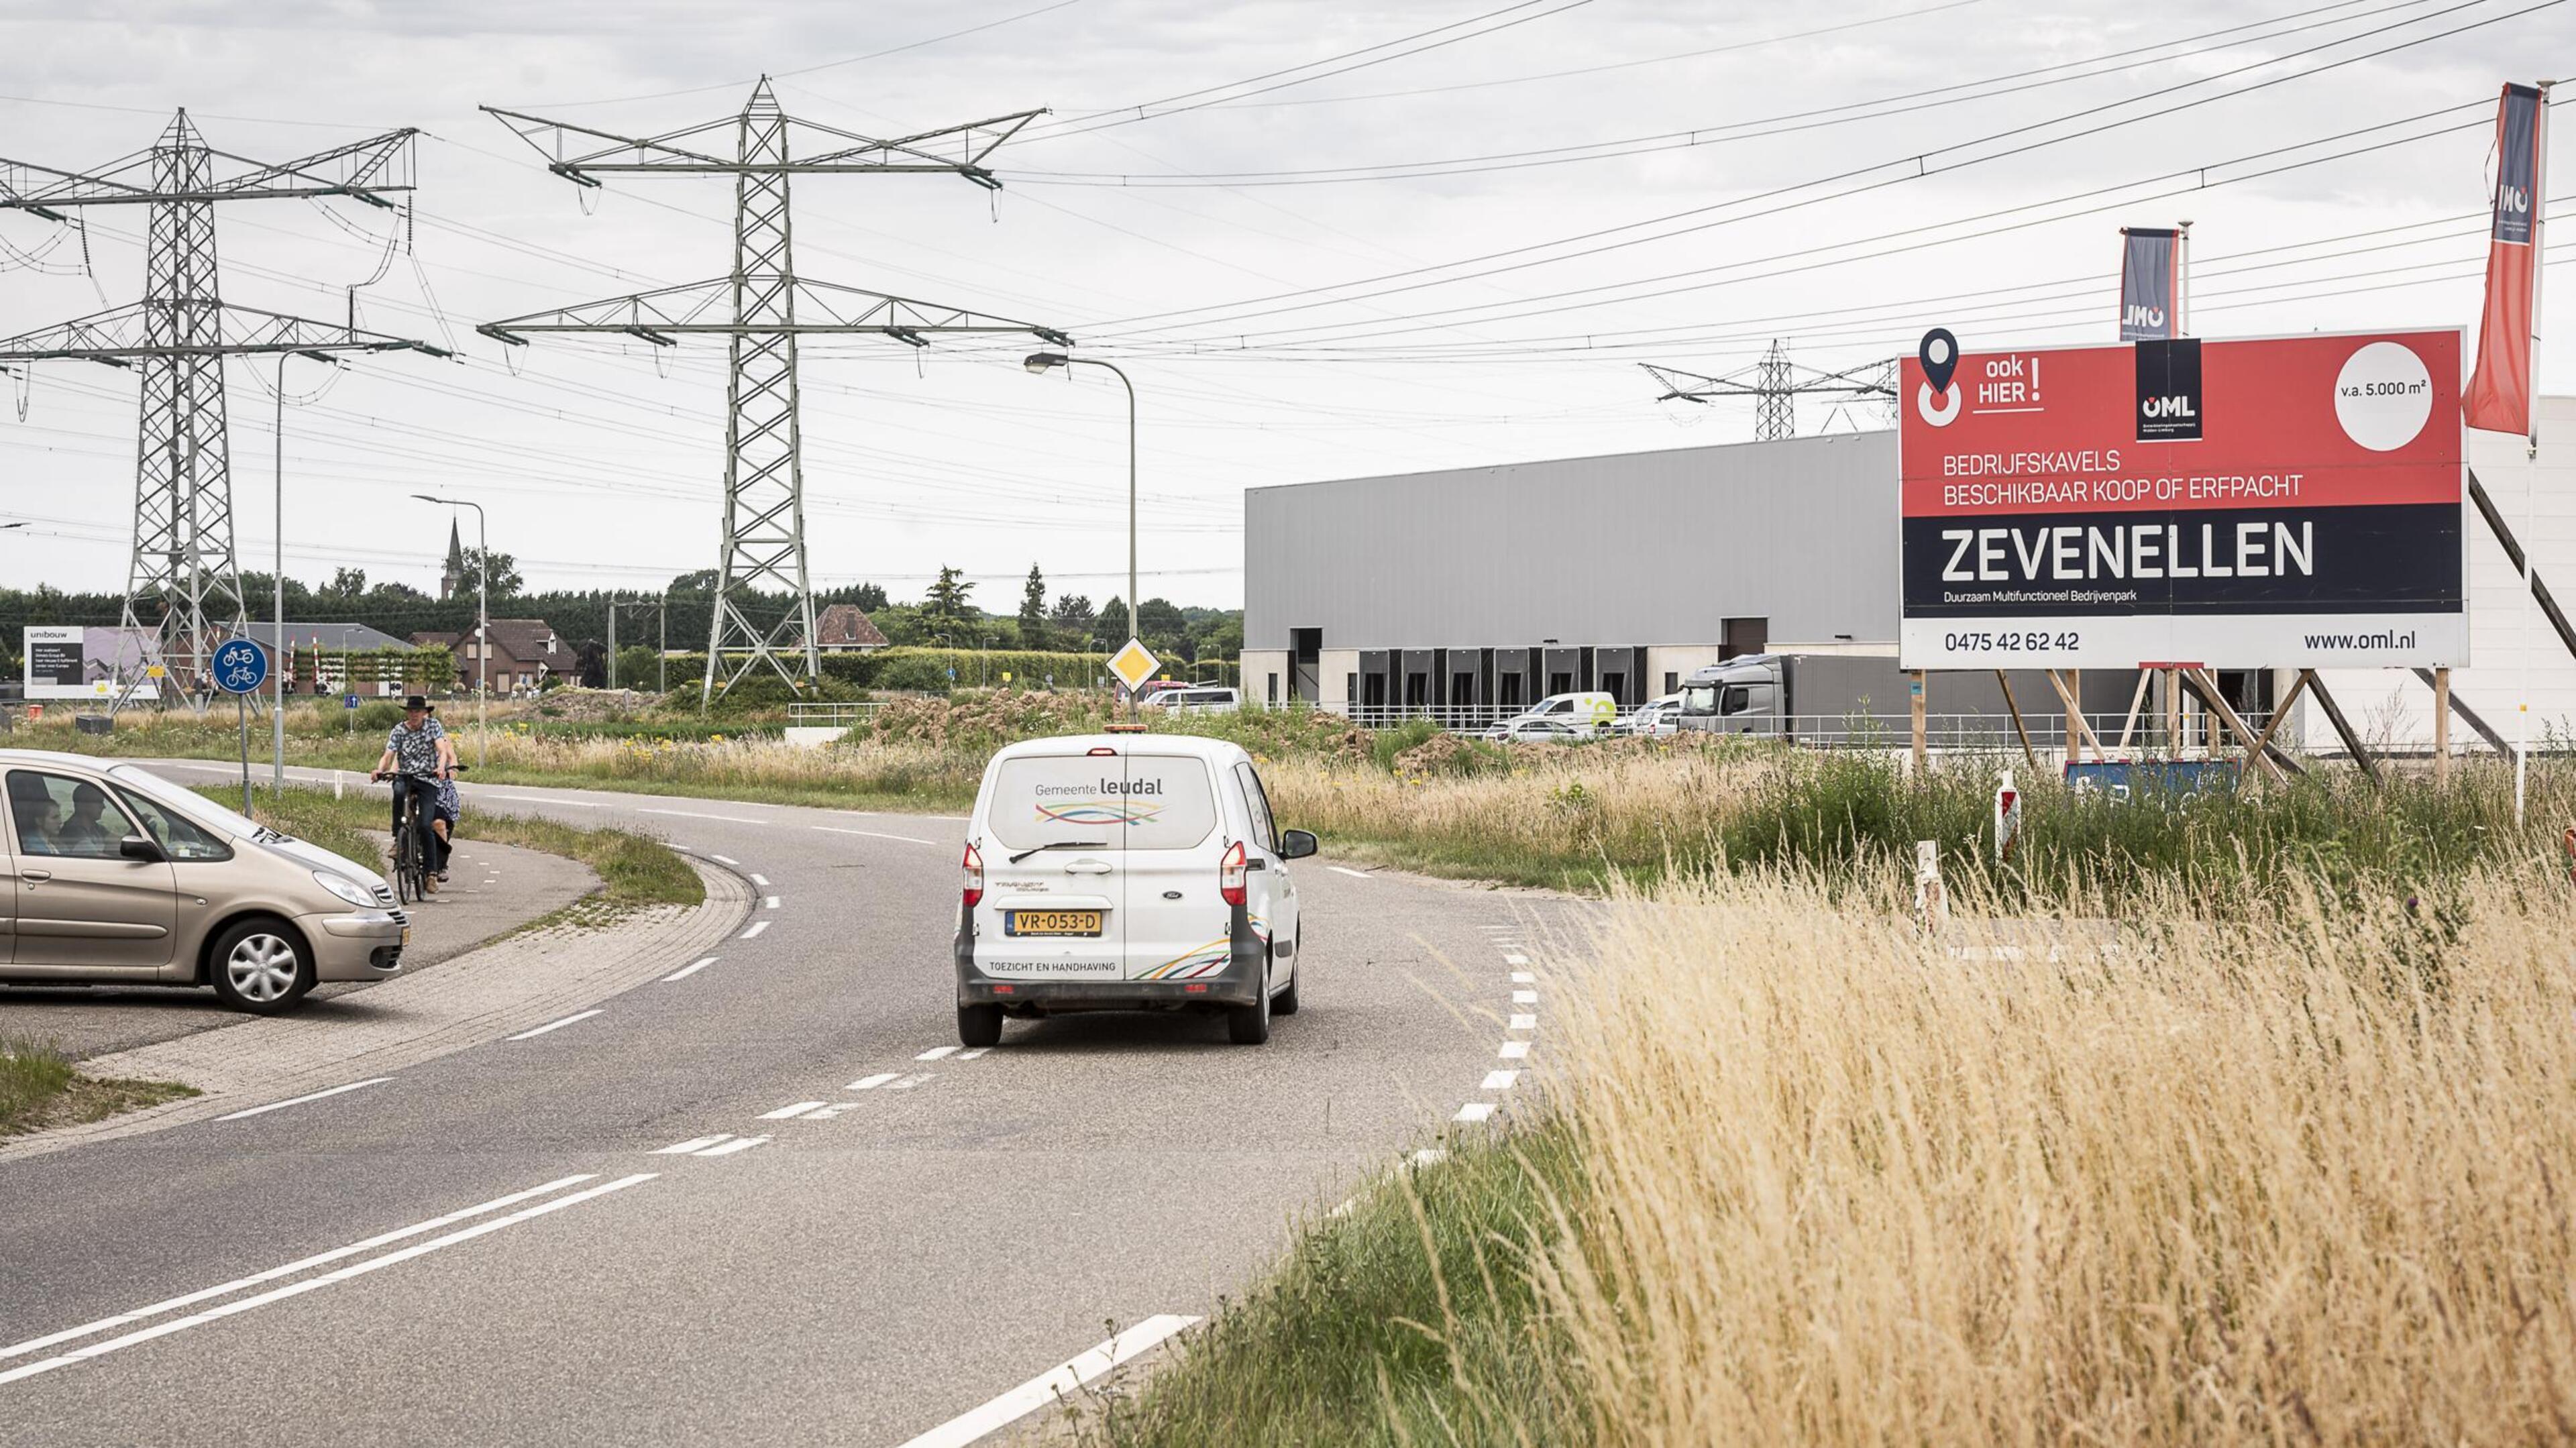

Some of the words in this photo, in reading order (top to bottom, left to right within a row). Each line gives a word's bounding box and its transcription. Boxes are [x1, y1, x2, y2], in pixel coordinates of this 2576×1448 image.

[1986, 353, 2024, 378] ook
[2341, 386, 2363, 397] v.a.
[2365, 382, 2406, 396] 5.000
[2409, 380, 2426, 394] m²
[2143, 396, 2196, 418] OML
[1943, 449, 2121, 476] BEDRIJFSKAVELS
[1944, 481, 2088, 506] BESCHIKBAAR
[2093, 479, 2151, 502] KOOP
[2155, 478, 2184, 500] OF
[2189, 474, 2304, 499] ERFPACHT
[1941, 521, 2313, 581] ZEVENELLEN
[1944, 591, 1991, 602] Duurzaam
[1992, 590, 2069, 602] Multifunctioneel
[2071, 590, 2137, 604] Bedrijvenpark
[1945, 632, 1992, 651] 0475
[1996, 632, 2021, 651] 42
[2025, 632, 2050, 651] 62
[2054, 632, 2080, 651] 42
[2304, 628, 2416, 649] www.oml.nl
[1035, 784, 1097, 796] Gemeente
[1100, 778, 1163, 795] leudal
[1020, 913, 1095, 930] VR-053-D
[989, 961, 1034, 972] TOEZICHT
[1036, 962, 1050, 972] EN
[1052, 962, 1116, 972] HANDHAVING
